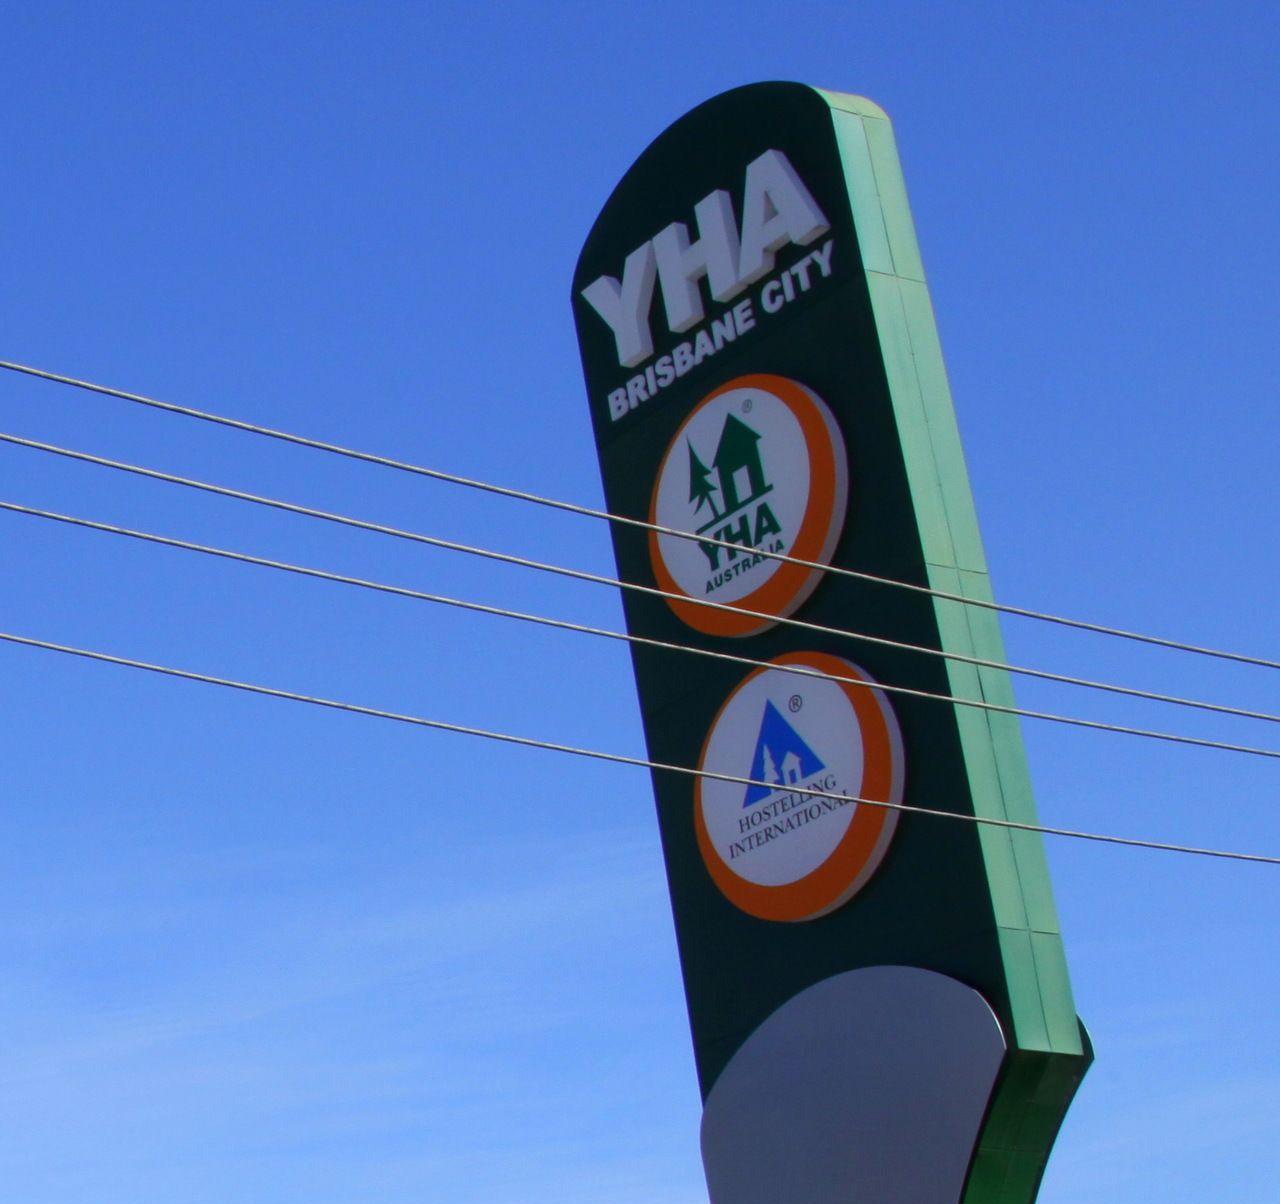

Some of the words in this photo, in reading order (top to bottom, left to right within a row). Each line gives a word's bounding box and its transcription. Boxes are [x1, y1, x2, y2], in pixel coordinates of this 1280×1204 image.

[581, 149, 831, 368] YHA
[607, 298, 757, 422] BRISBANE
[760, 239, 835, 316] CITY
[695, 502, 782, 572] YHA
[705, 540, 785, 594] AUSTRALIA
[728, 792, 855, 860] INTERNATIONAL
[738, 774, 837, 834] HOSTELLING
